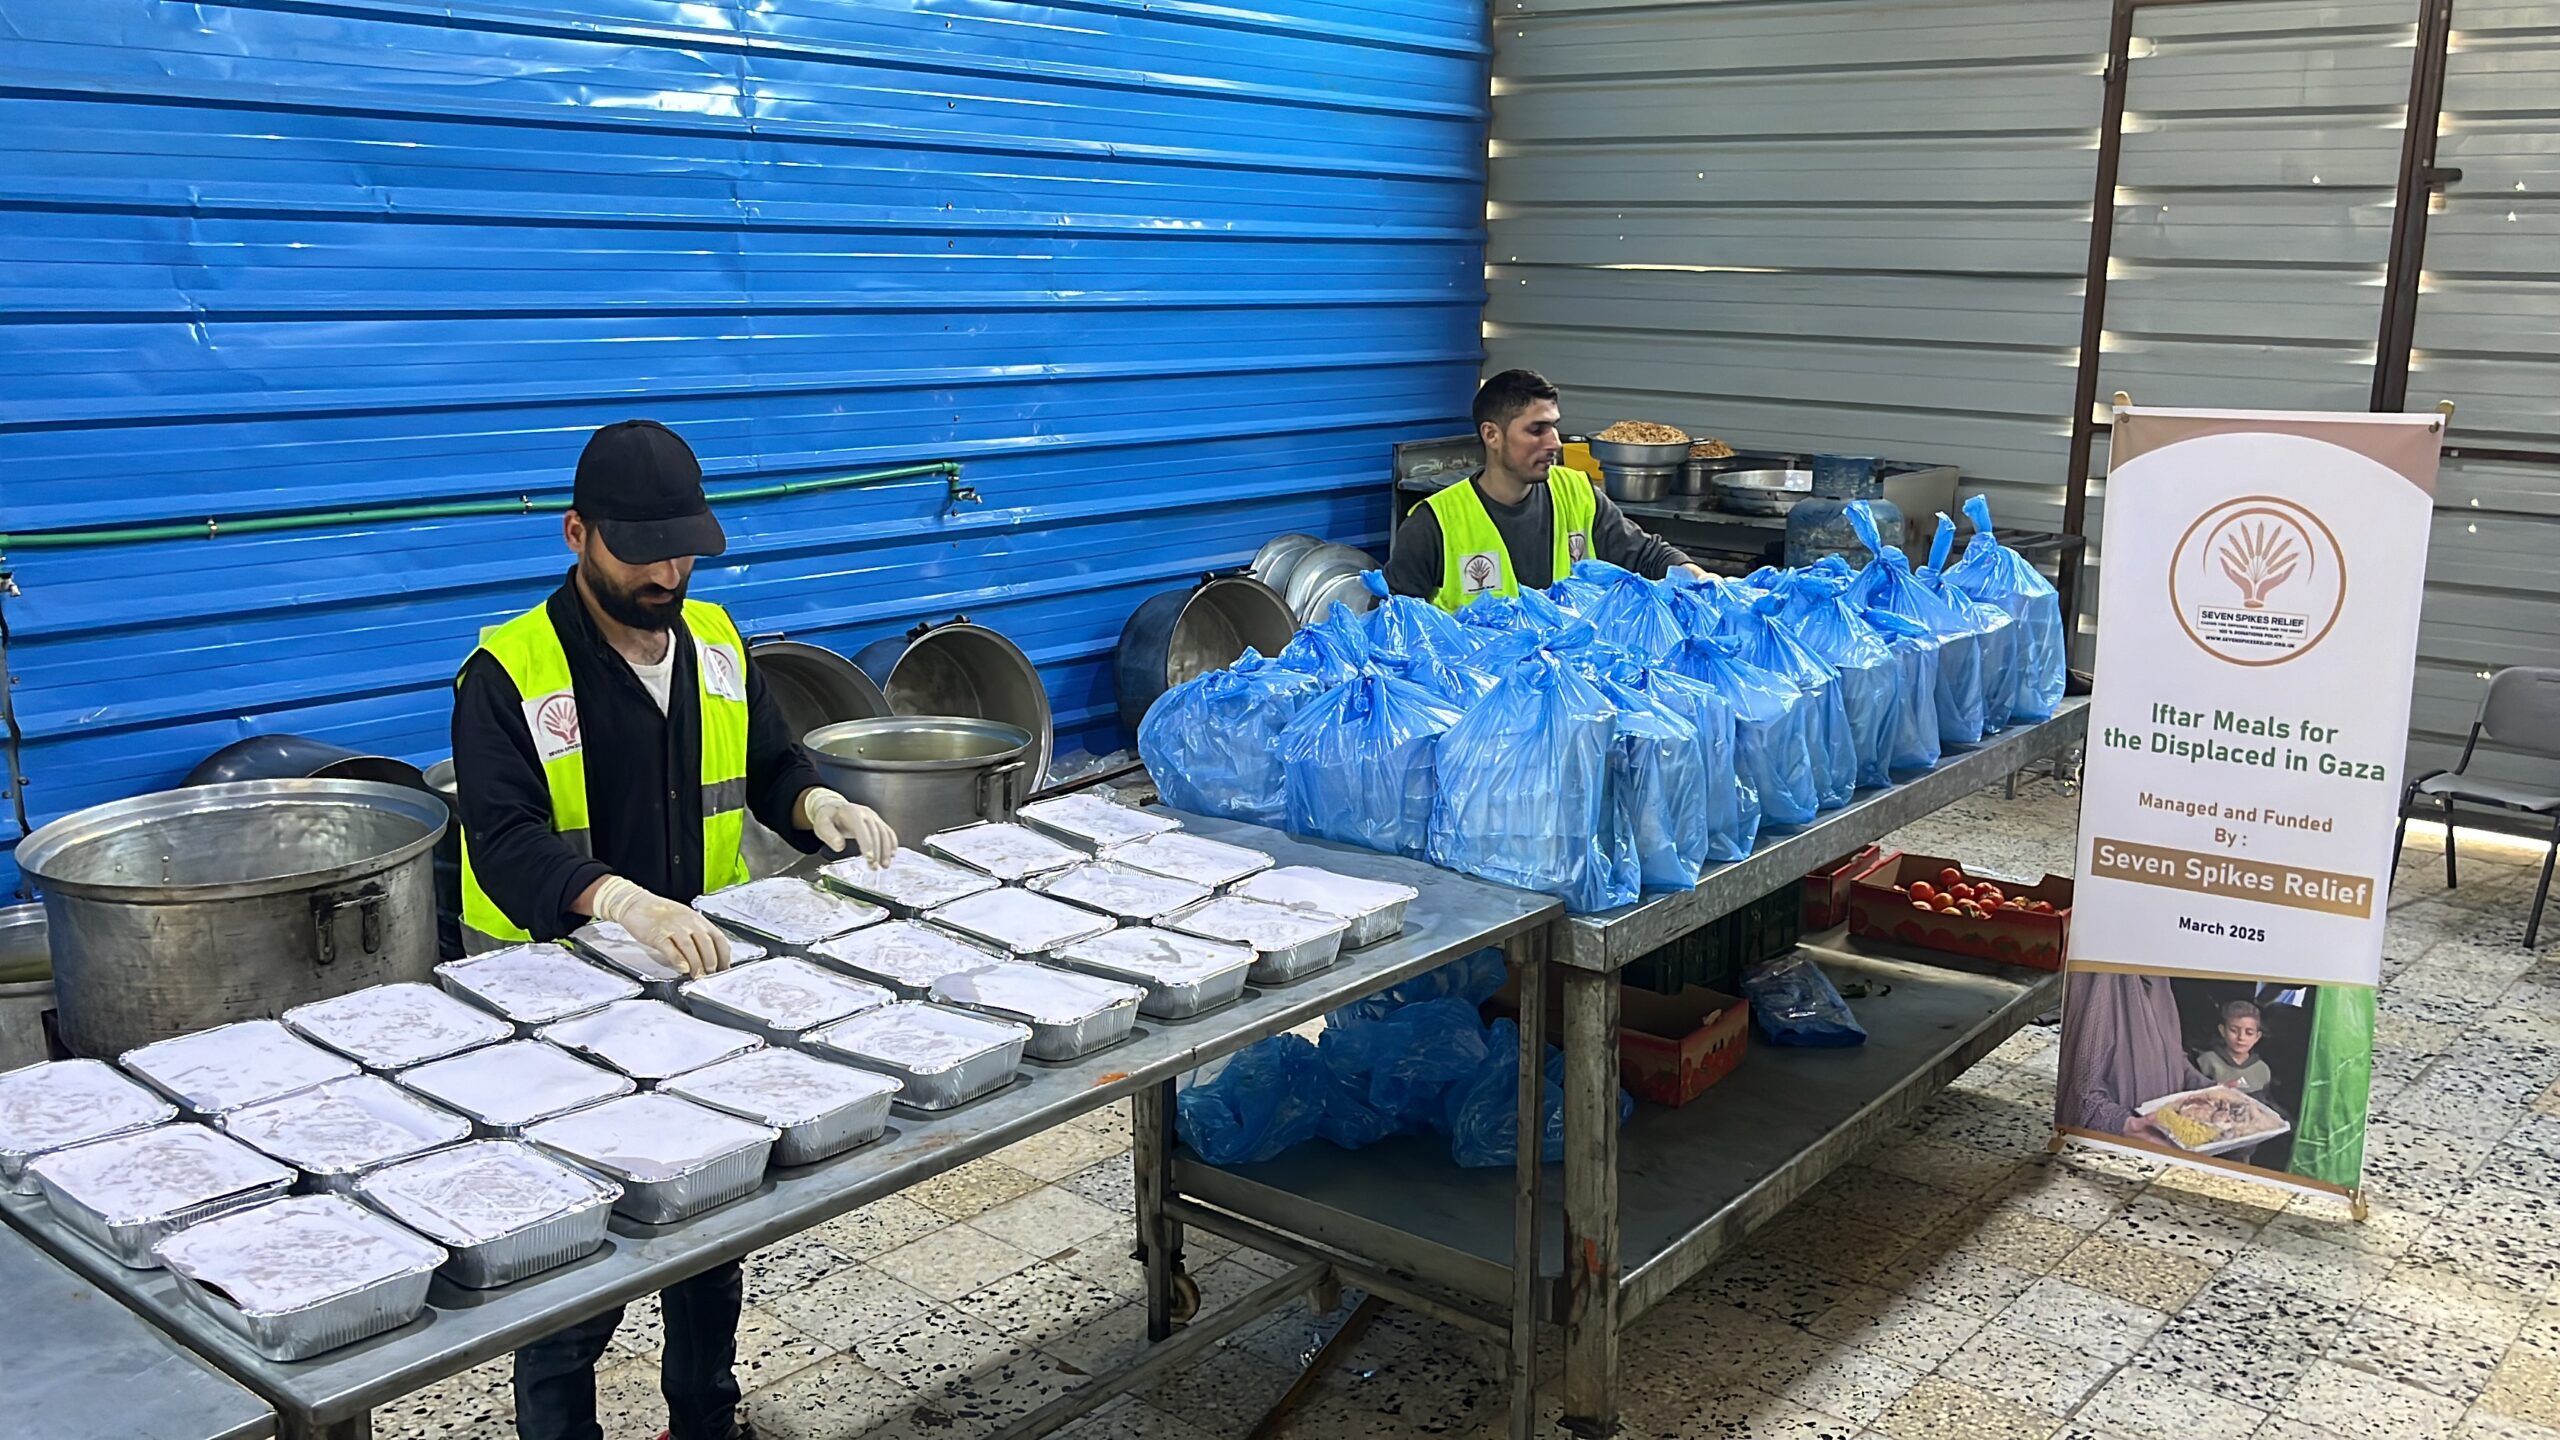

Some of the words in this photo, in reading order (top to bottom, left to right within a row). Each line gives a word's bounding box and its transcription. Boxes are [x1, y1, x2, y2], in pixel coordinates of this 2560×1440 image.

[2201, 611, 2234, 621] SEVEN
[2235, 614, 2269, 624] SPIKES
[2271, 617, 2304, 627] RELIEF
[2151, 703, 2204, 728] Iftar
[2213, 710, 2291, 739] Meals
[2299, 720, 2339, 744] for
[2104, 727, 2142, 750] the
[2151, 733, 2276, 768] Displaced
[2285, 749, 2308, 771] in
[2318, 753, 2386, 781] Gaza
[2139, 792, 2218, 817] Managed
[2224, 808, 2257, 822] and
[2264, 810, 2333, 832] Funded
[2214, 828, 2237, 848] By
[2099, 846, 2176, 876] Seven
[2184, 859, 2274, 891] Spikes
[2285, 873, 2367, 906] Relief
[2179, 917, 2224, 936] March
[2229, 925, 2265, 942] 2025
